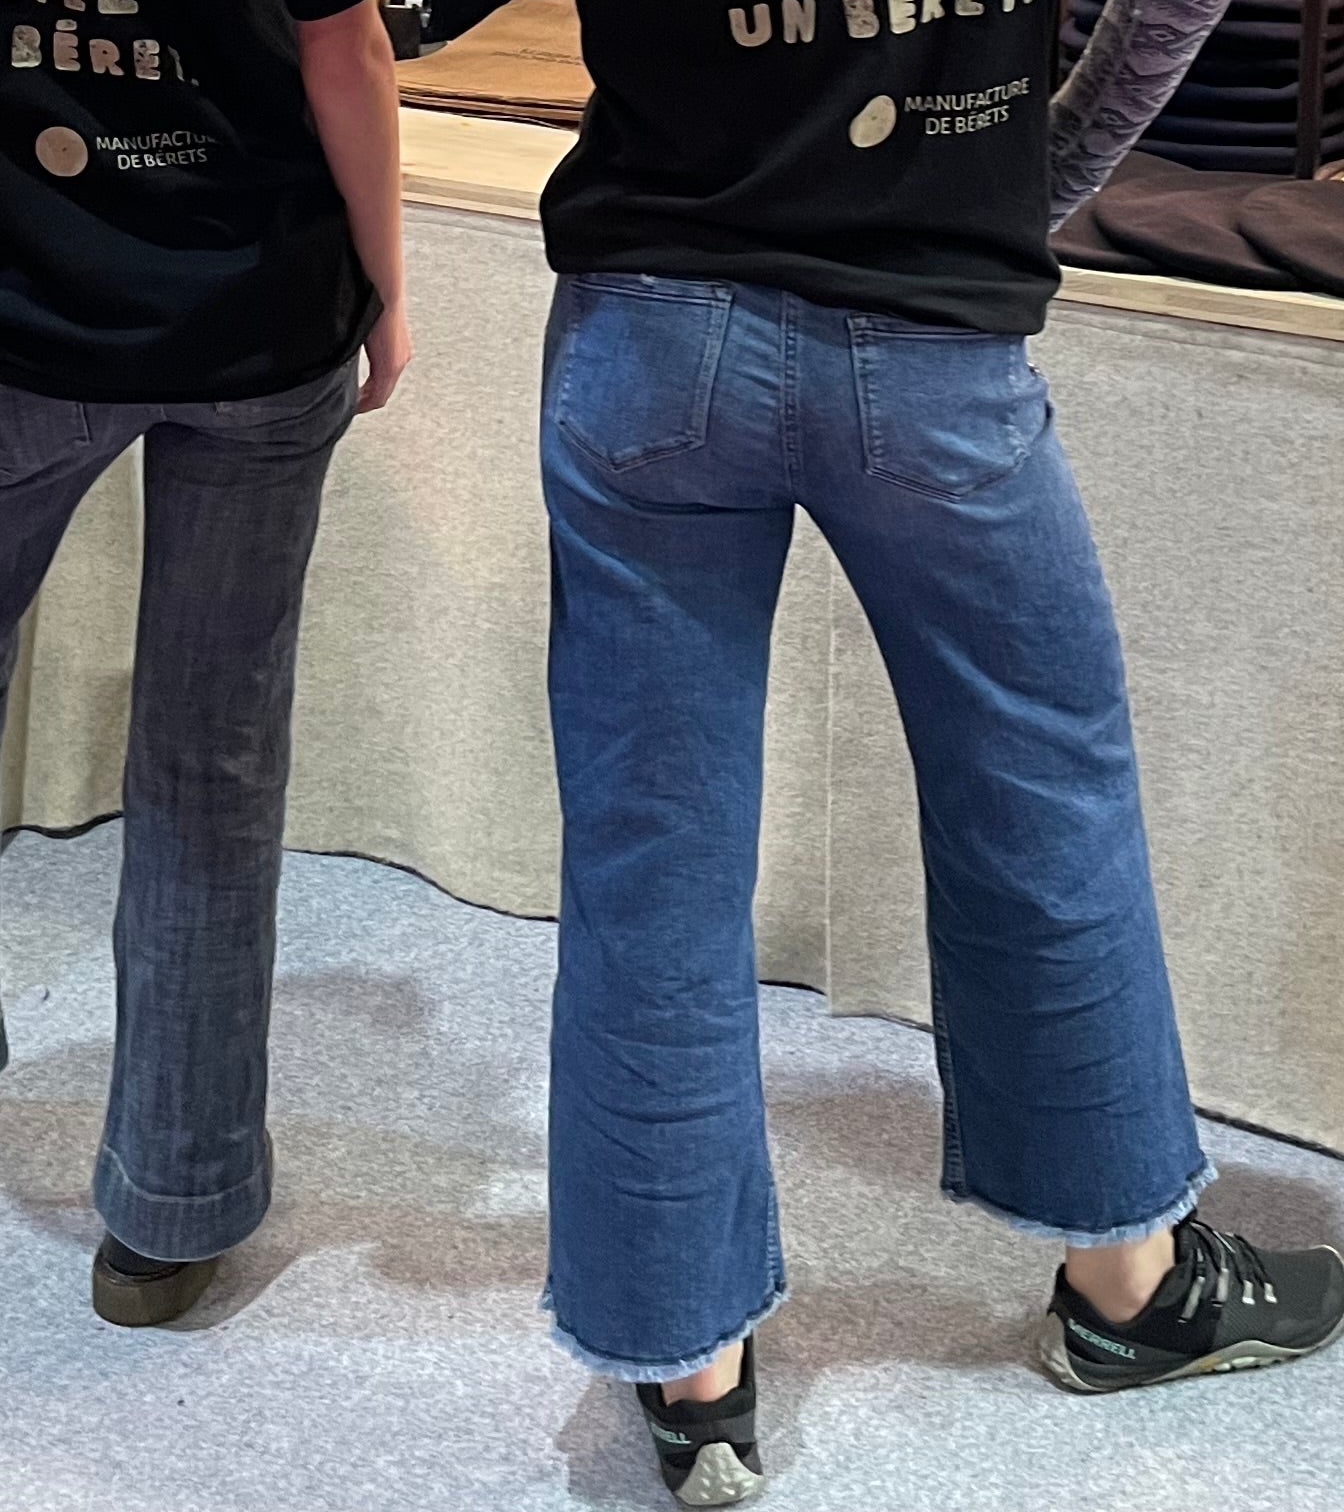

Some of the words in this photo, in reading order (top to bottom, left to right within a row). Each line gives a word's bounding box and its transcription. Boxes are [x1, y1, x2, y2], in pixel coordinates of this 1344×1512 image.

[904, 77, 1031, 113] MANUFACTURE
[925, 117, 953, 136] DE
[955, 104, 1010, 134] BÉRETS
[116, 154, 143, 170] DE
[143, 148, 208, 168] BÉRETS
